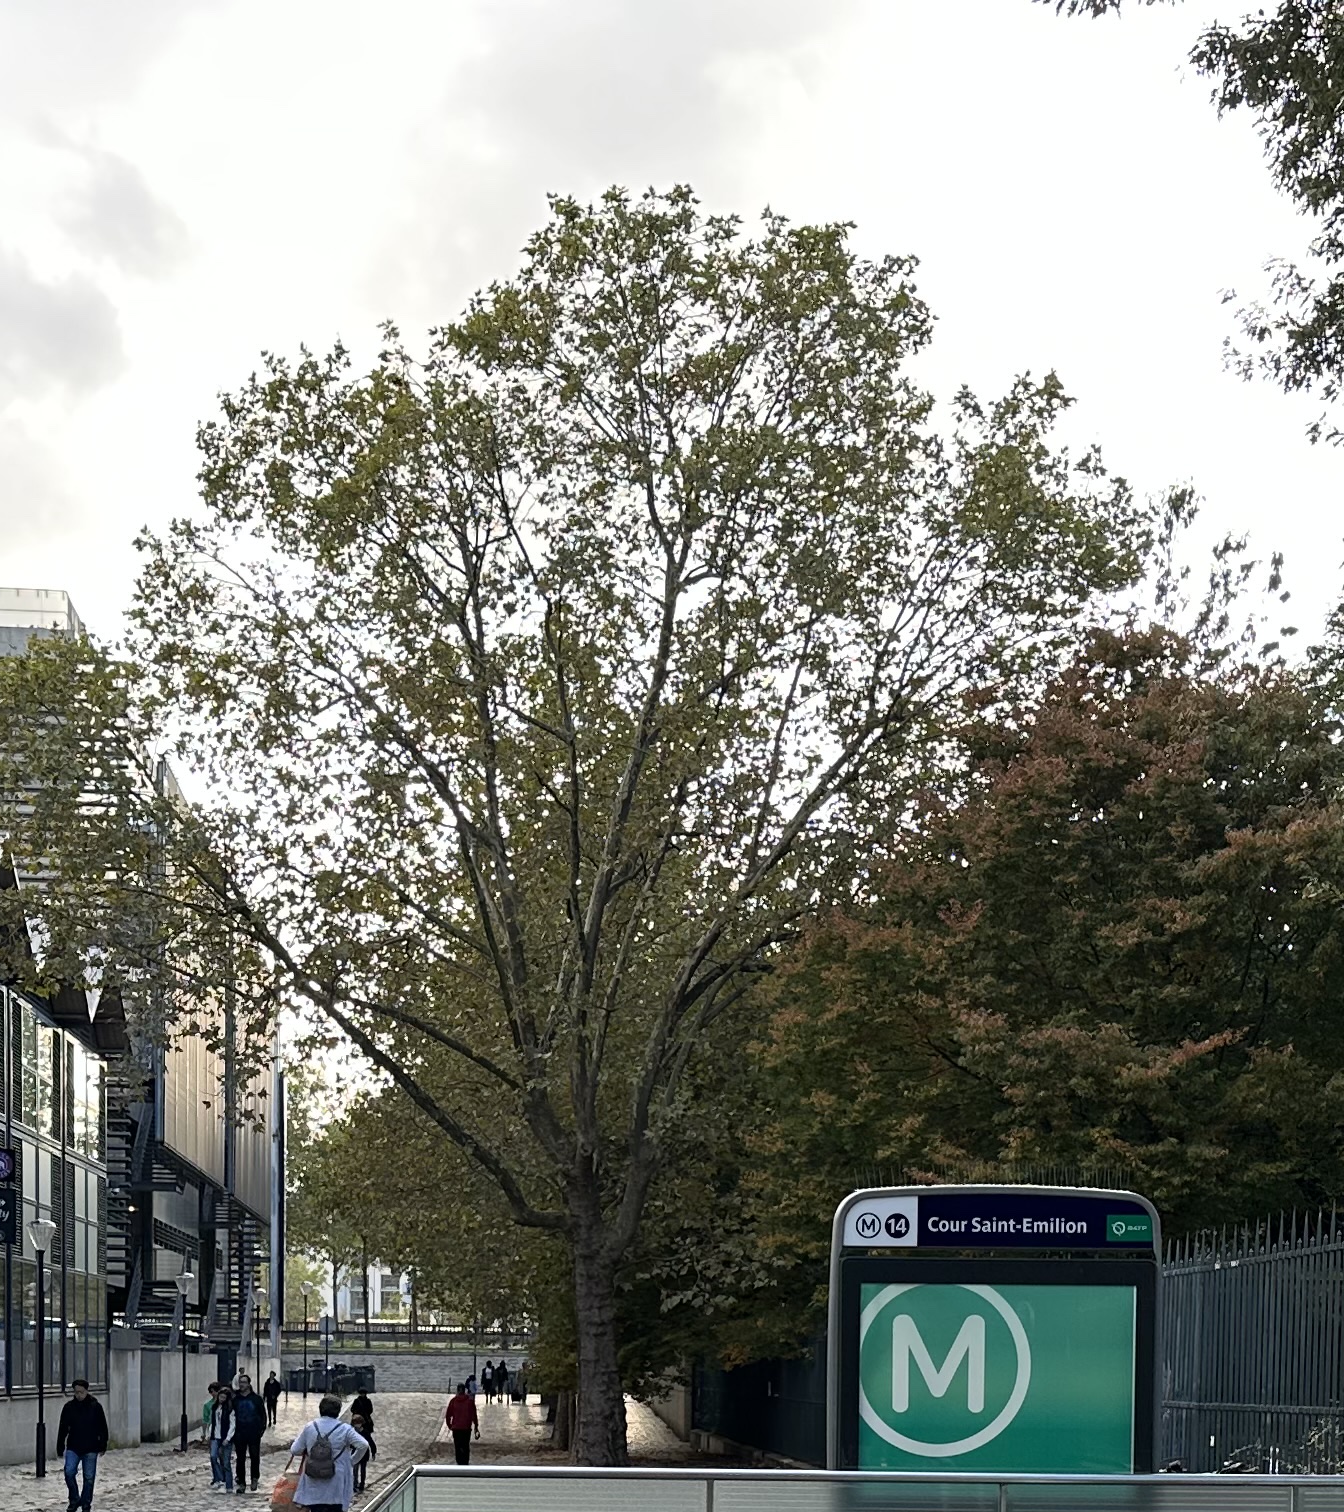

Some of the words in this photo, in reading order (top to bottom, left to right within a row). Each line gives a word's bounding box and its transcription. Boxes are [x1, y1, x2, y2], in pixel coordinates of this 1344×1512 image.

[887, 1217, 907, 1234] 14
[927, 1216, 968, 1232] Cour
[971, 1216, 1088, 1234] Saint-Emilion
[892, 1314, 985, 1413] M
